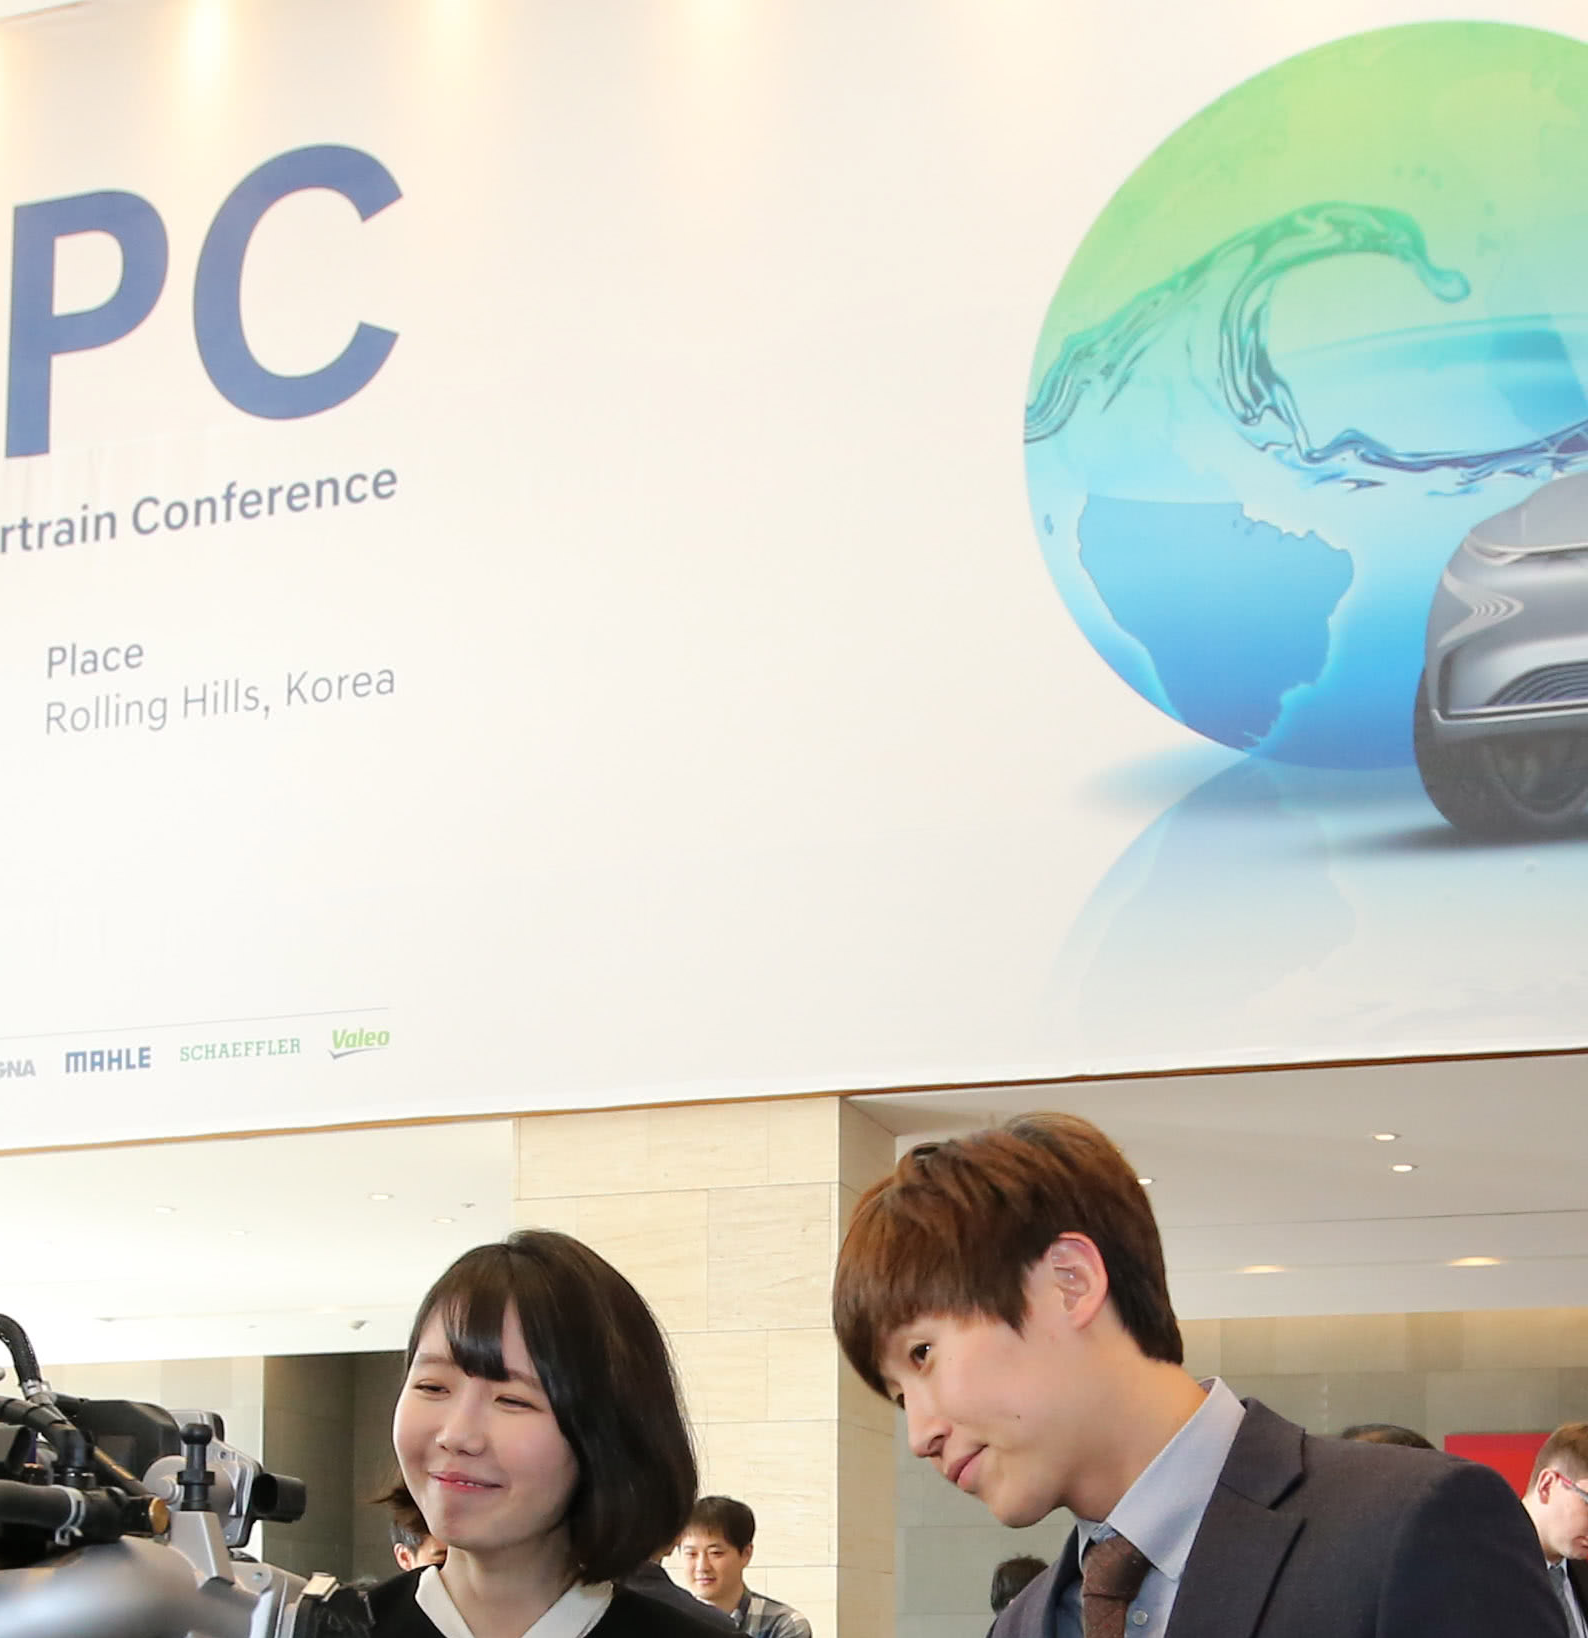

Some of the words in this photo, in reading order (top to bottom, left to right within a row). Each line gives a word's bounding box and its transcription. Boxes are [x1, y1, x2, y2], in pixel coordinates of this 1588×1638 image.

[130, 468, 399, 536] Conference
[46, 640, 145, 680] Place
[45, 691, 169, 736] Rolling
[182, 678, 271, 721] Hills,
[285, 669, 396, 708] Korea
[65, 1046, 151, 1074] MAHLE
[179, 1037, 302, 1063] SCHAEFFLER
[331, 1027, 391, 1050] Valeo
